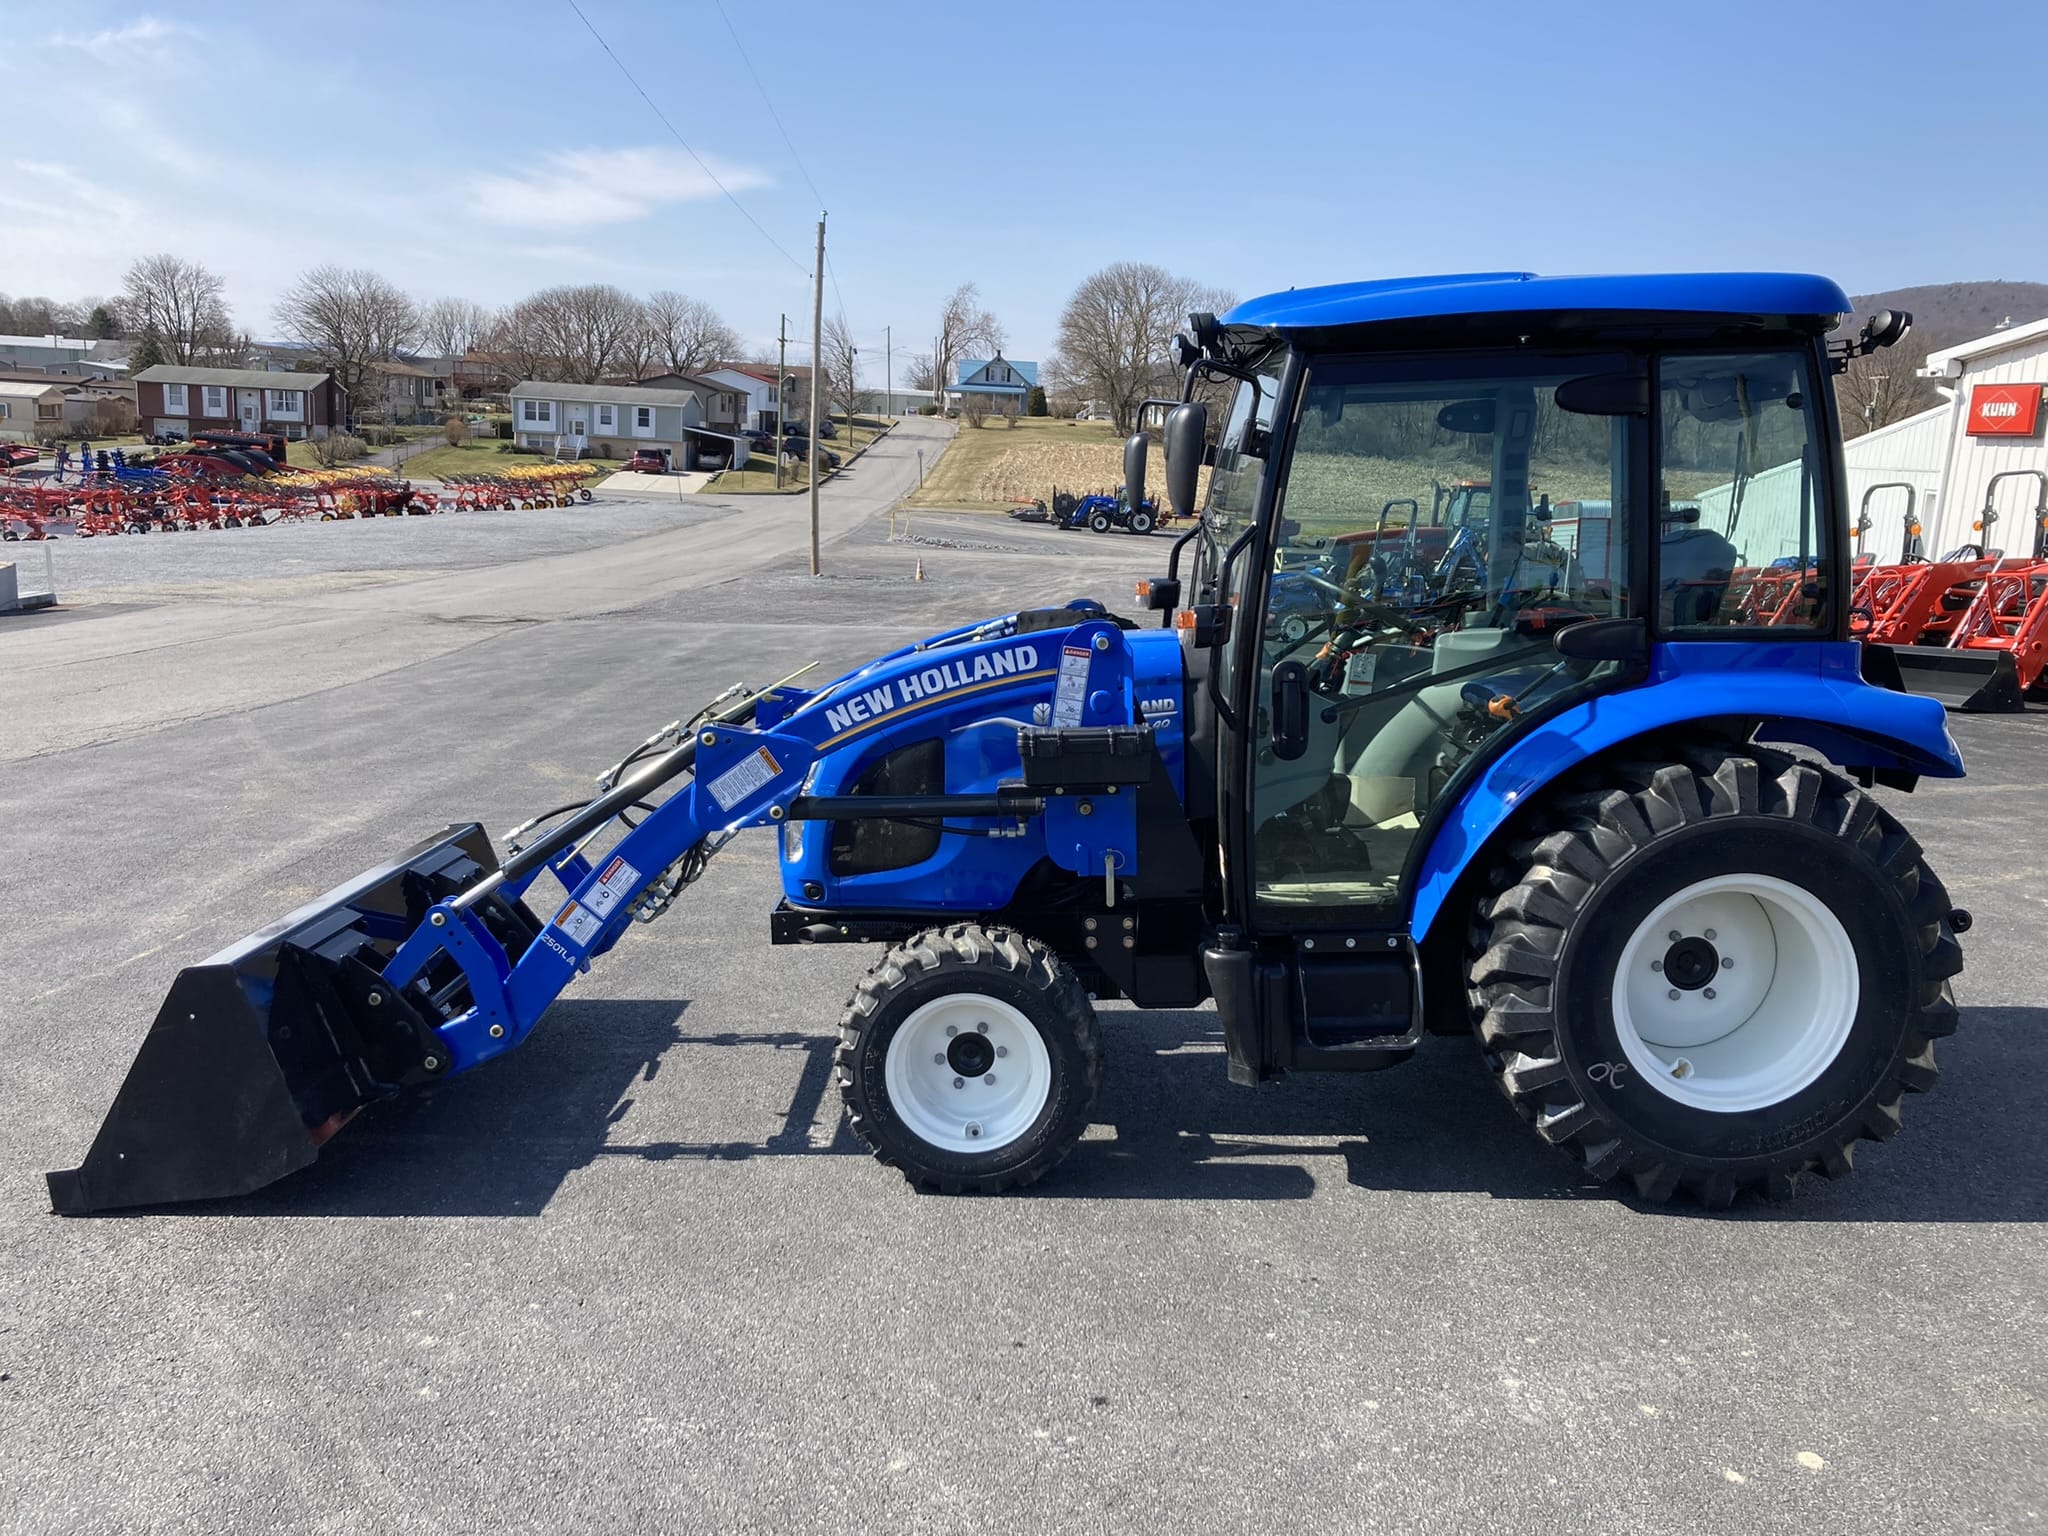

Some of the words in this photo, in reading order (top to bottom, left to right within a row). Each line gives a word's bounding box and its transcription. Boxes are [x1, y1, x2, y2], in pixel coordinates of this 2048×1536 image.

[1982, 402, 2017, 416] KUHN
[825, 685, 894, 732] NEW
[898, 645, 1038, 702] HOLLAND
[542, 933, 576, 966] 250TLA
